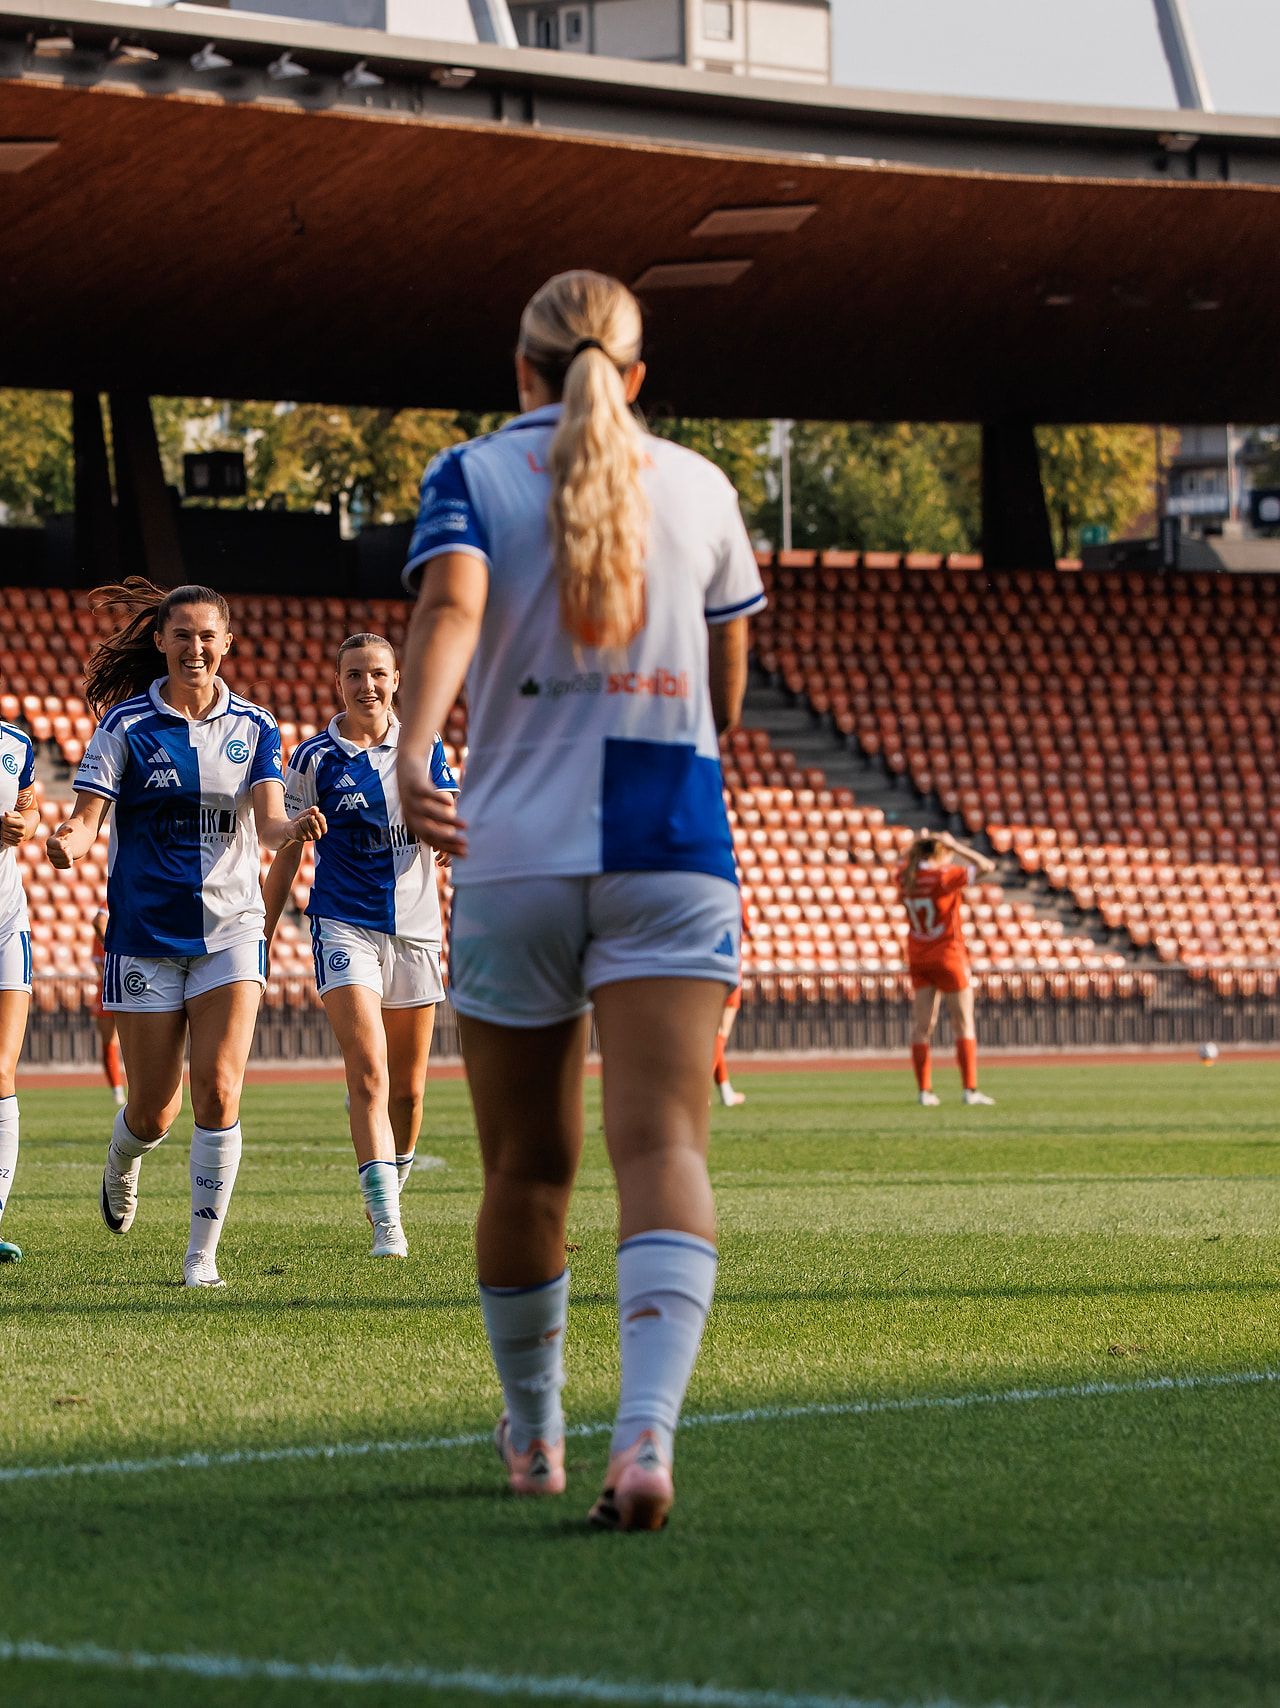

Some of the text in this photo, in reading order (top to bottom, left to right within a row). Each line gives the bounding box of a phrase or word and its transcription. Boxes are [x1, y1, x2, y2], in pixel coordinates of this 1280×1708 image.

[144, 768, 182, 788] AXA
[335, 792, 370, 811] AXA
[195, 1175, 224, 1191] GCZ
